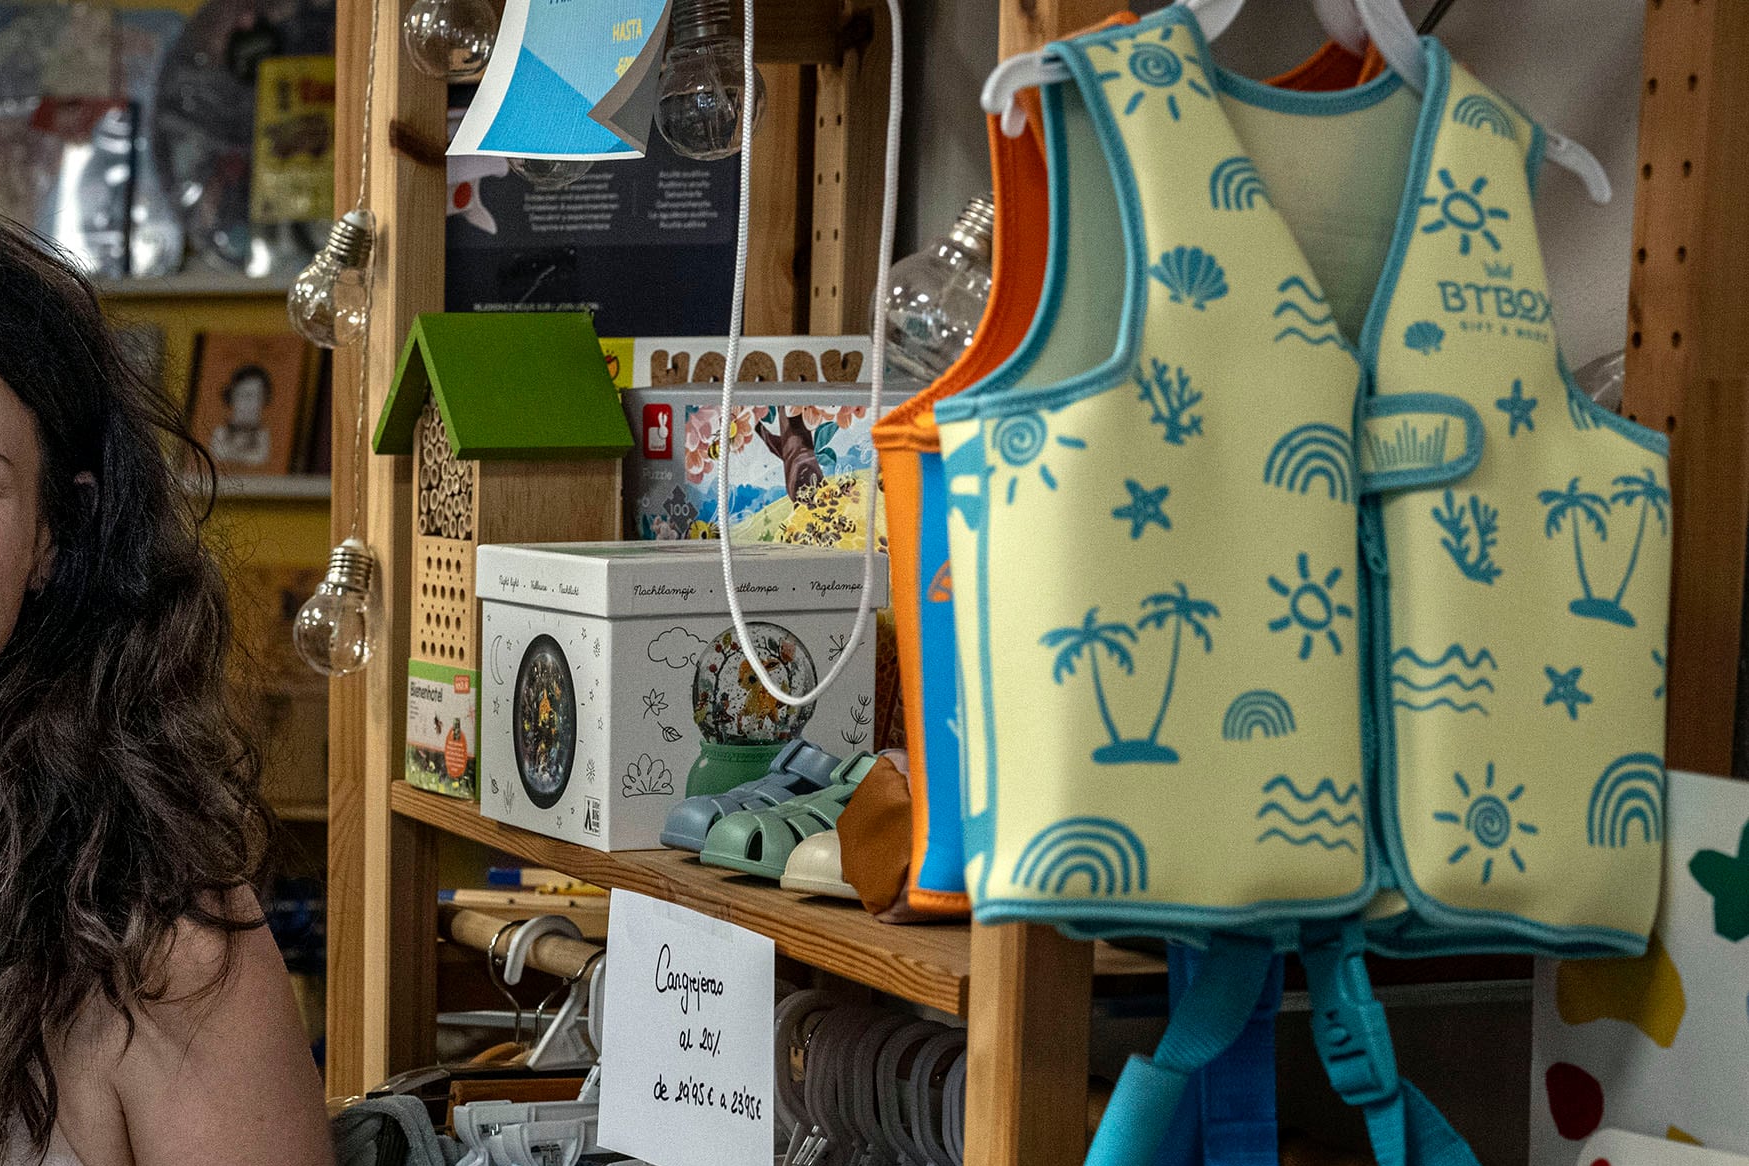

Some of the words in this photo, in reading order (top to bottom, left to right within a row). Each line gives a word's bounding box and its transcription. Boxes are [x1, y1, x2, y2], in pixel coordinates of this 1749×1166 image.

[612, 17, 643, 43] HASTA
[669, 503, 690, 517] 100
[633, 584, 697, 602] Nachtlampje
[735, 583, 780, 595] attlampa
[410, 681, 443, 703] Bienenhotel
[655, 943, 724, 1014] Cangrejeras
[679, 1028, 693, 1051] al
[653, 1074, 669, 1101] de
[720, 1093, 727, 1110] a
